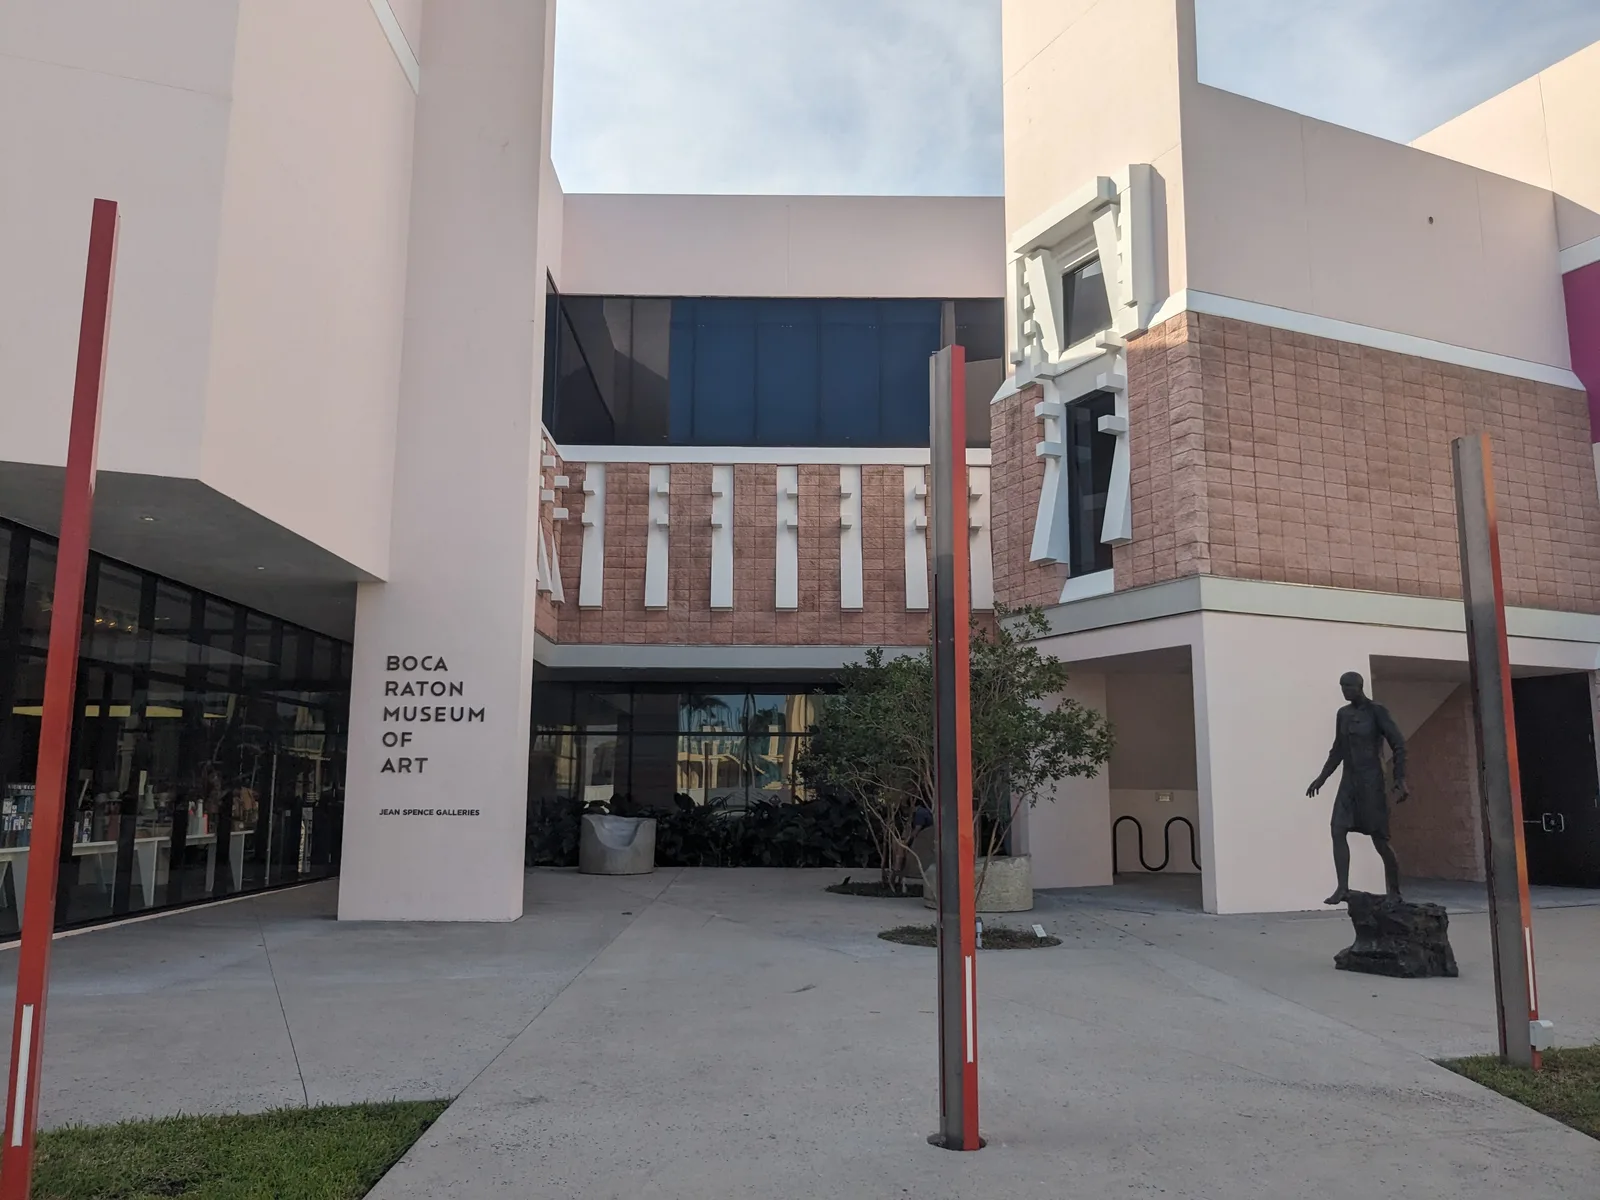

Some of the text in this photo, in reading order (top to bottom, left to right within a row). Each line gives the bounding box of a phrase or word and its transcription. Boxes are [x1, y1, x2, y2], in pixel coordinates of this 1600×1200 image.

[385, 655, 449, 672] BOCA
[384, 680, 464, 697] RATON
[383, 706, 486, 723] MUSEUM
[382, 731, 413, 748] OF
[380, 757, 429, 774] ART
[379, 808, 480, 817] JEAN SPENCE GALLERIES
